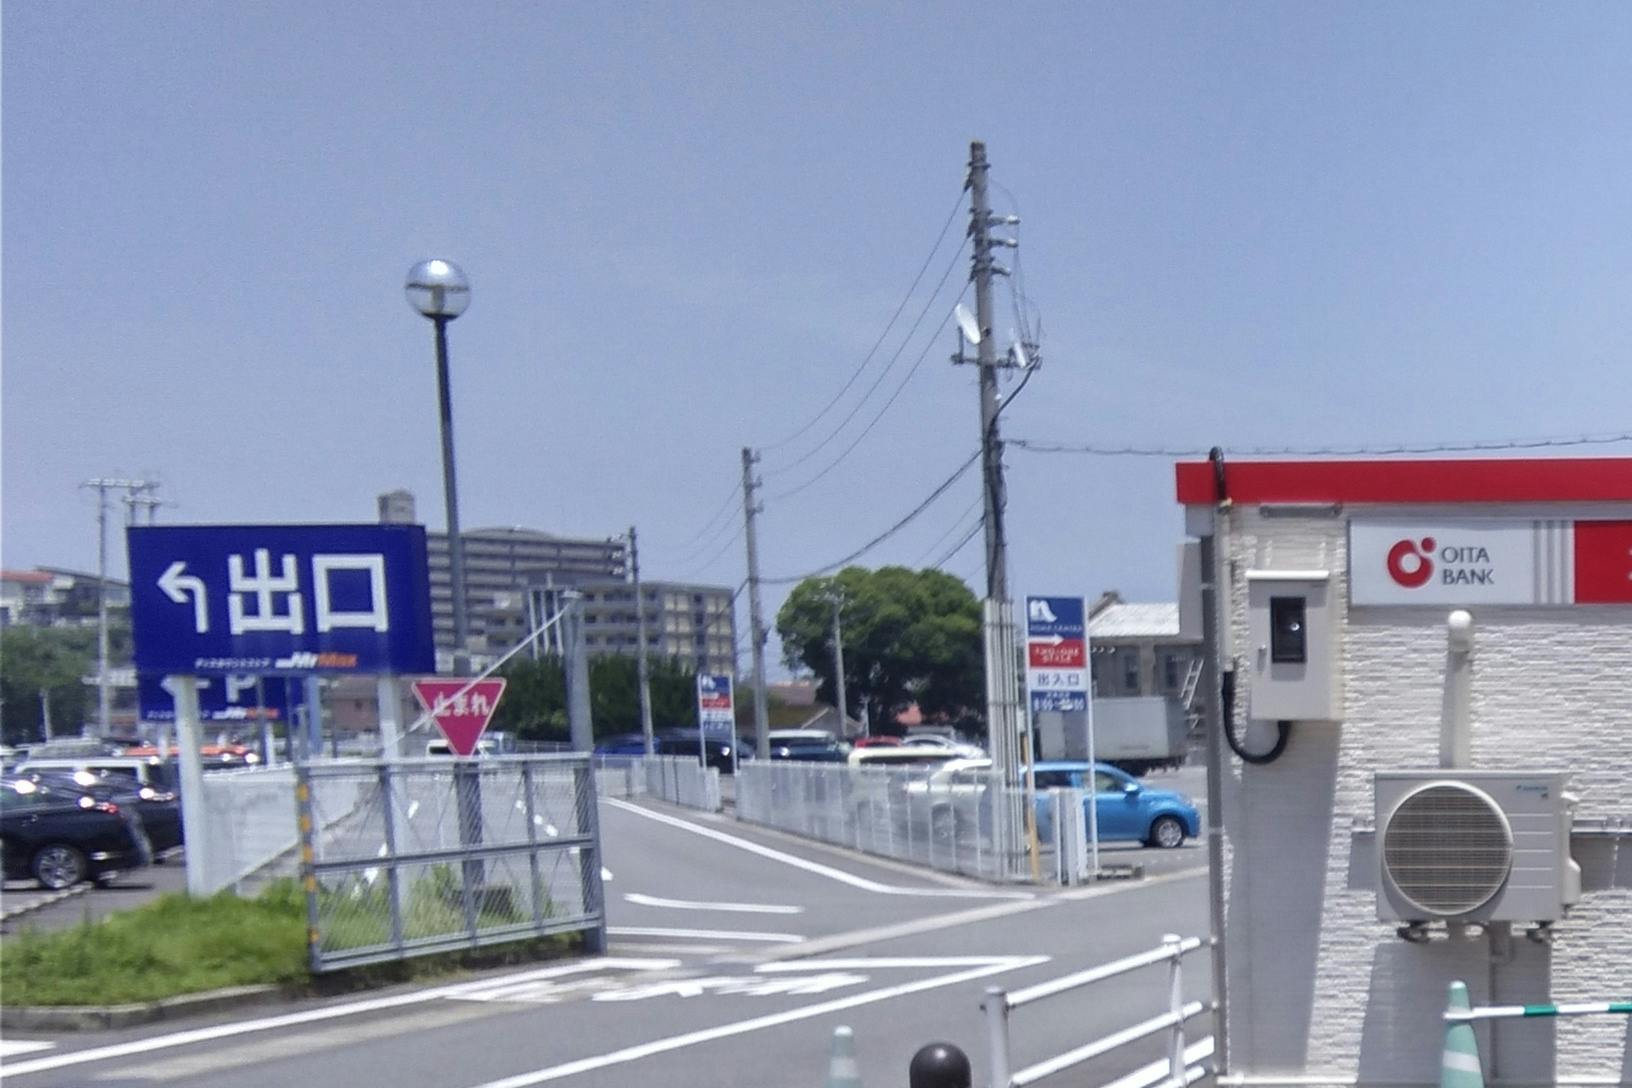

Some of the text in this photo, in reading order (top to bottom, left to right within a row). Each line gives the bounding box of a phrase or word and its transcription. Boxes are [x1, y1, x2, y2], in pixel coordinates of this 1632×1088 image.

[1441, 546, 1490, 563] OITA
[1442, 568, 1495, 585] BANK
[227, 548, 388, 635] 出口
[1038, 673, 1080, 687] 出入口
